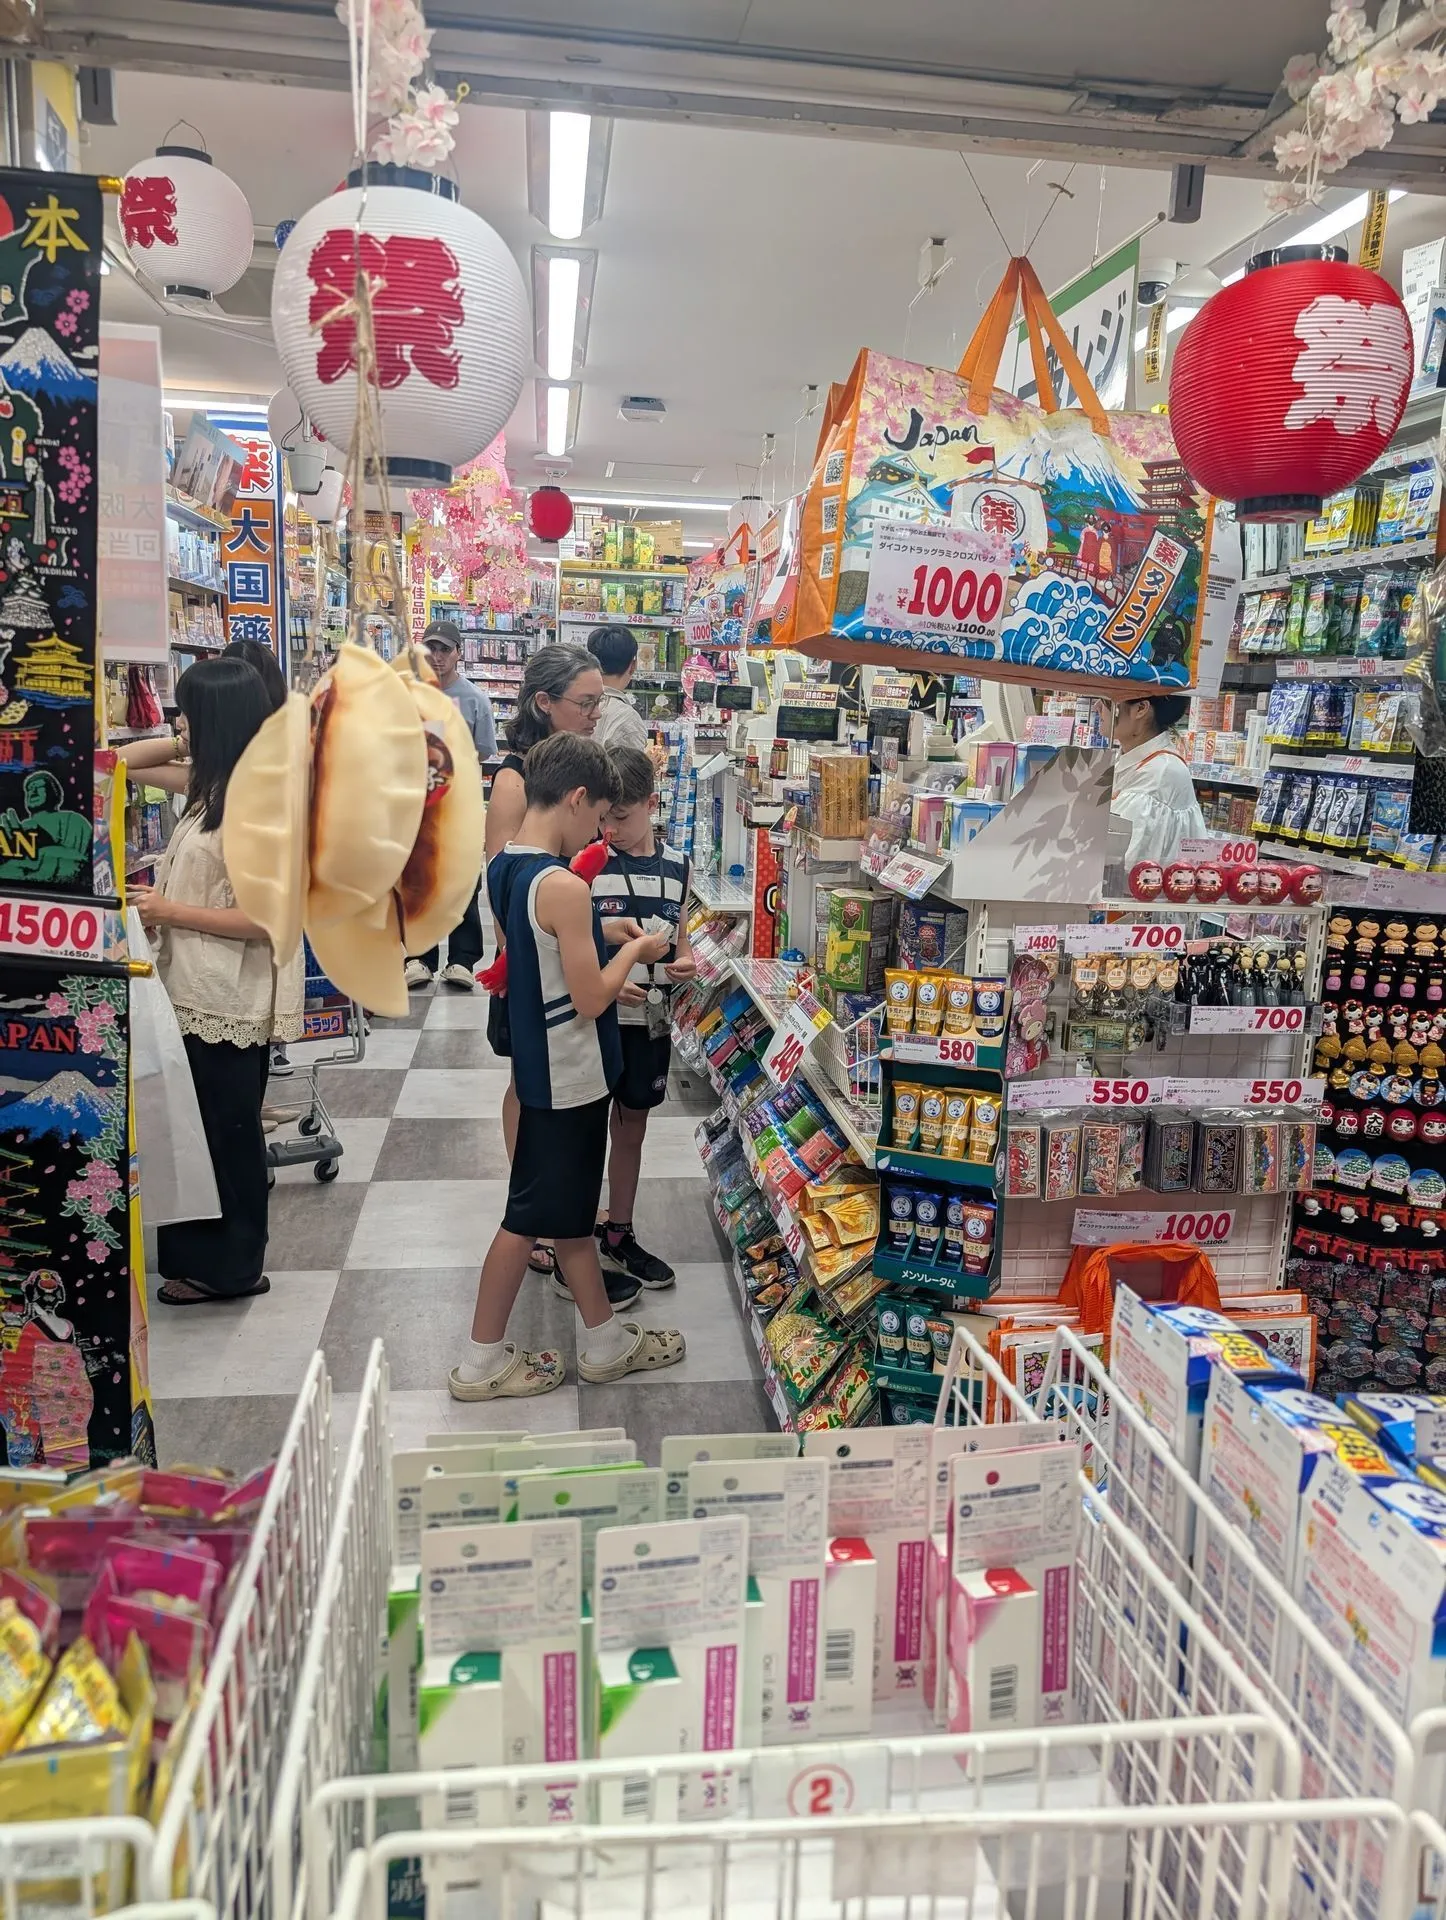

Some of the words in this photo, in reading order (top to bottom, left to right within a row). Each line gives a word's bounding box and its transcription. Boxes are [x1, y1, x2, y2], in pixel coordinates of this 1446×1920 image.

[21, 193, 91, 264] 本
[306, 228, 466, 392] 祭
[883, 407, 995, 462] Japan
[981, 494, 1018, 536] 薬
[878, 542, 998, 564] ダイコクドラッグラミクロスバッグ
[907, 564, 1004, 624] 1000
[1110, 567, 1168, 644] ダイコク
[692, 624, 711, 641] 1000
[1222, 842, 1257, 864] 600
[600, 901, 623, 911] AFL
[0, 904, 98, 951] 1500
[1131, 926, 1182, 948] 700
[1027, 935, 1057, 950] 1480
[1254, 1008, 1303, 1030] 700
[0, 1022, 77, 1053] PAN
[939, 1039, 975, 1062] 580
[1092, 1081, 1149, 1105] 550
[1249, 1080, 1303, 1104] 550
[1336, 1125, 1358, 1135] JAPAN
[1161, 1212, 1231, 1241] 1000
[901, 1269, 955, 1289] メンソレータム
[809, 1778, 833, 1813] 2
